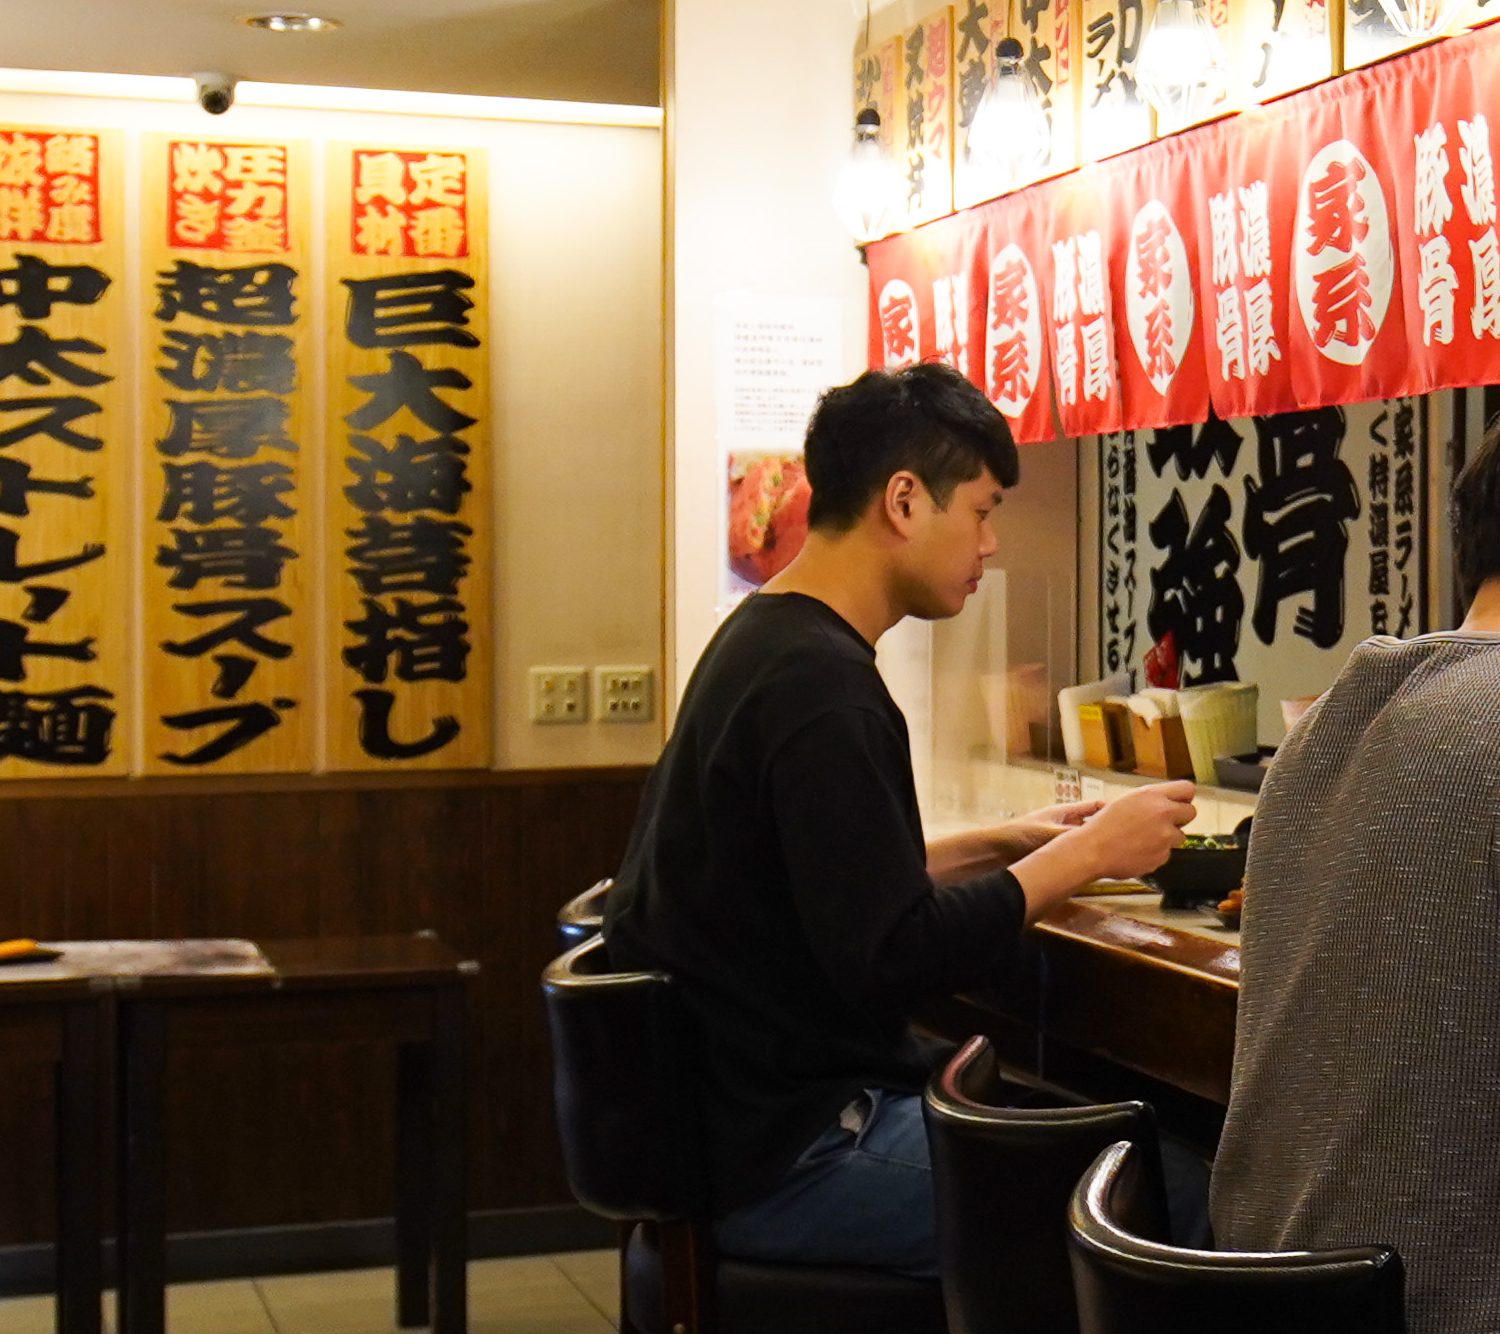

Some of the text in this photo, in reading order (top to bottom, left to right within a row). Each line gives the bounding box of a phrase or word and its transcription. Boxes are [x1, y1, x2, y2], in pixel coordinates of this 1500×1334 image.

[354, 152, 468, 255] 定番 具材
[1132, 213, 1174, 383] 家系
[1209, 190, 1245, 382] 豚骨
[1239, 180, 1282, 379] 濃厚
[1305, 159, 1377, 349] 家系
[1413, 123, 1455, 345] 豚骨
[991, 258, 1031, 403] 家系
[154, 261, 300, 767] 超濃厚豚骨スープ
